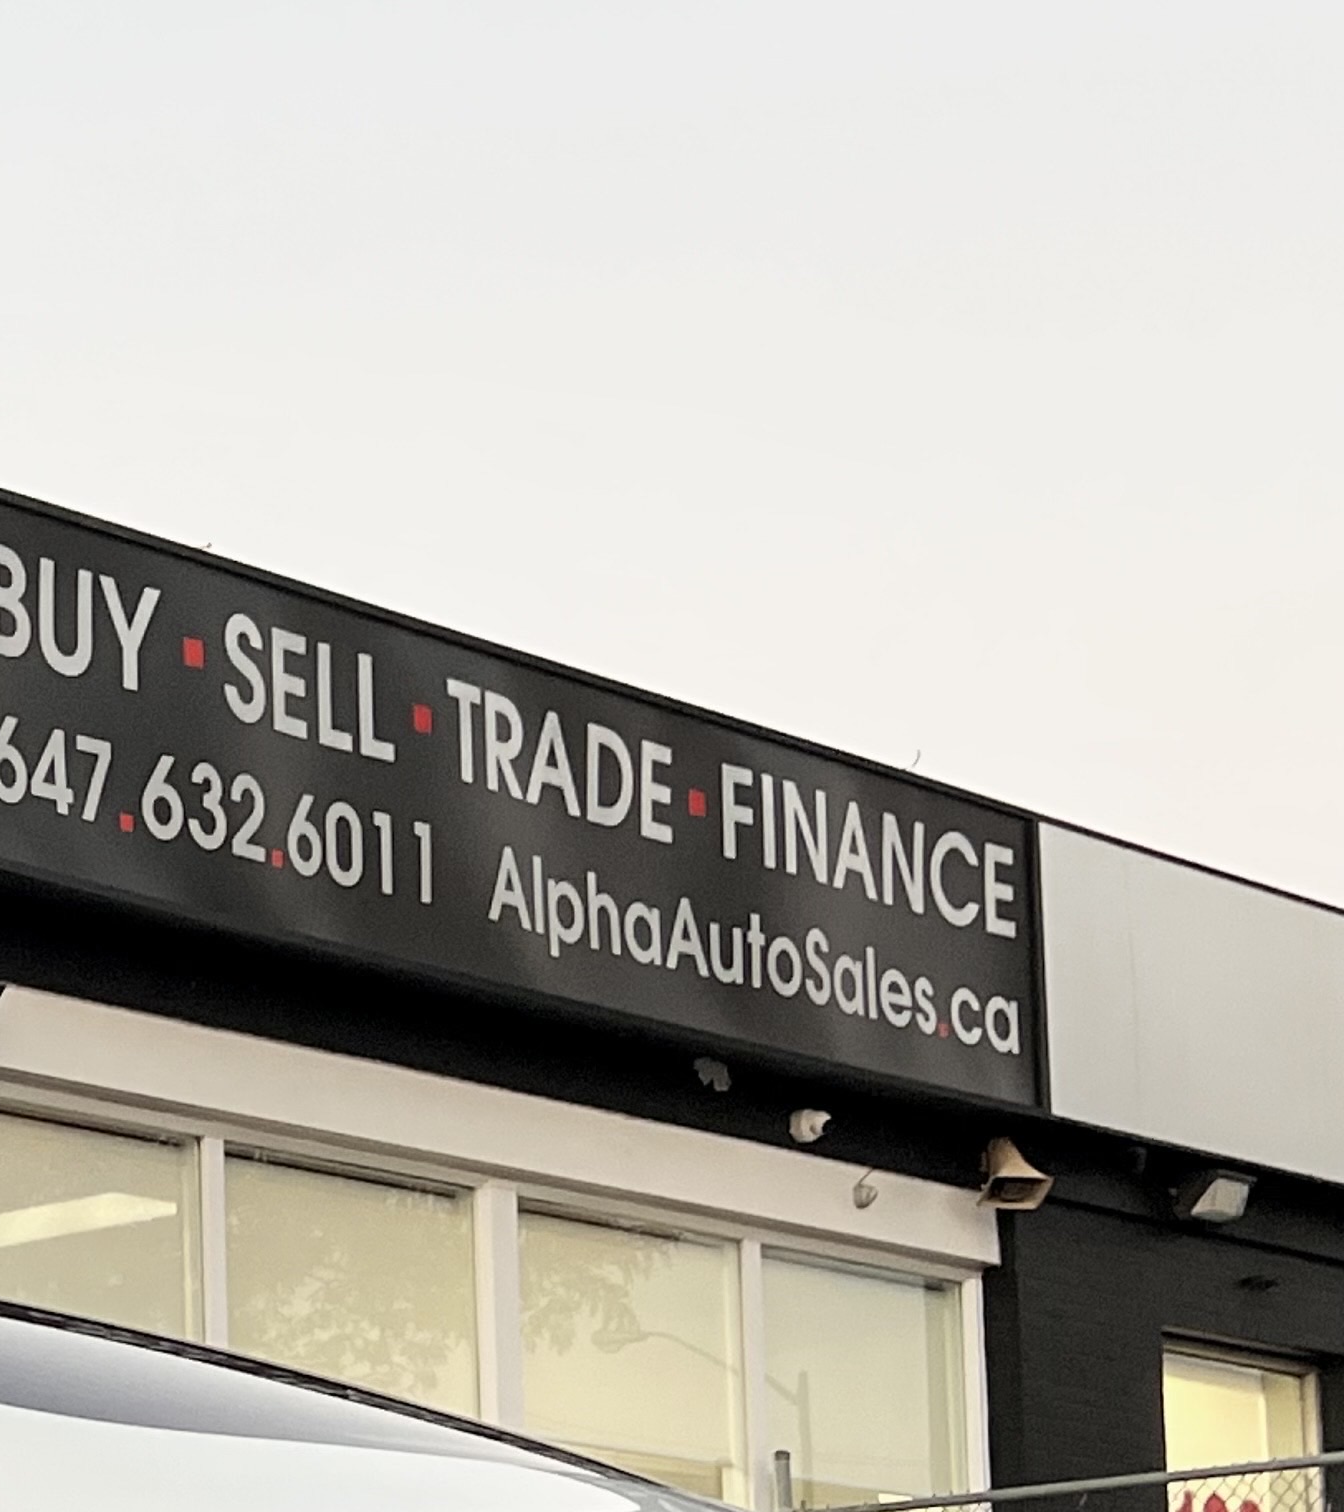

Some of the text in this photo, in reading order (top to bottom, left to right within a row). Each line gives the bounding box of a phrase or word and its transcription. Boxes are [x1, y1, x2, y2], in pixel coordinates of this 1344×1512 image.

[222, 612, 396, 764] SELL
[445, 676, 674, 845] TRADE
[720, 761, 1017, 940] FINANCE
[487, 844, 1021, 1056] AlphaAutoSales.ca
